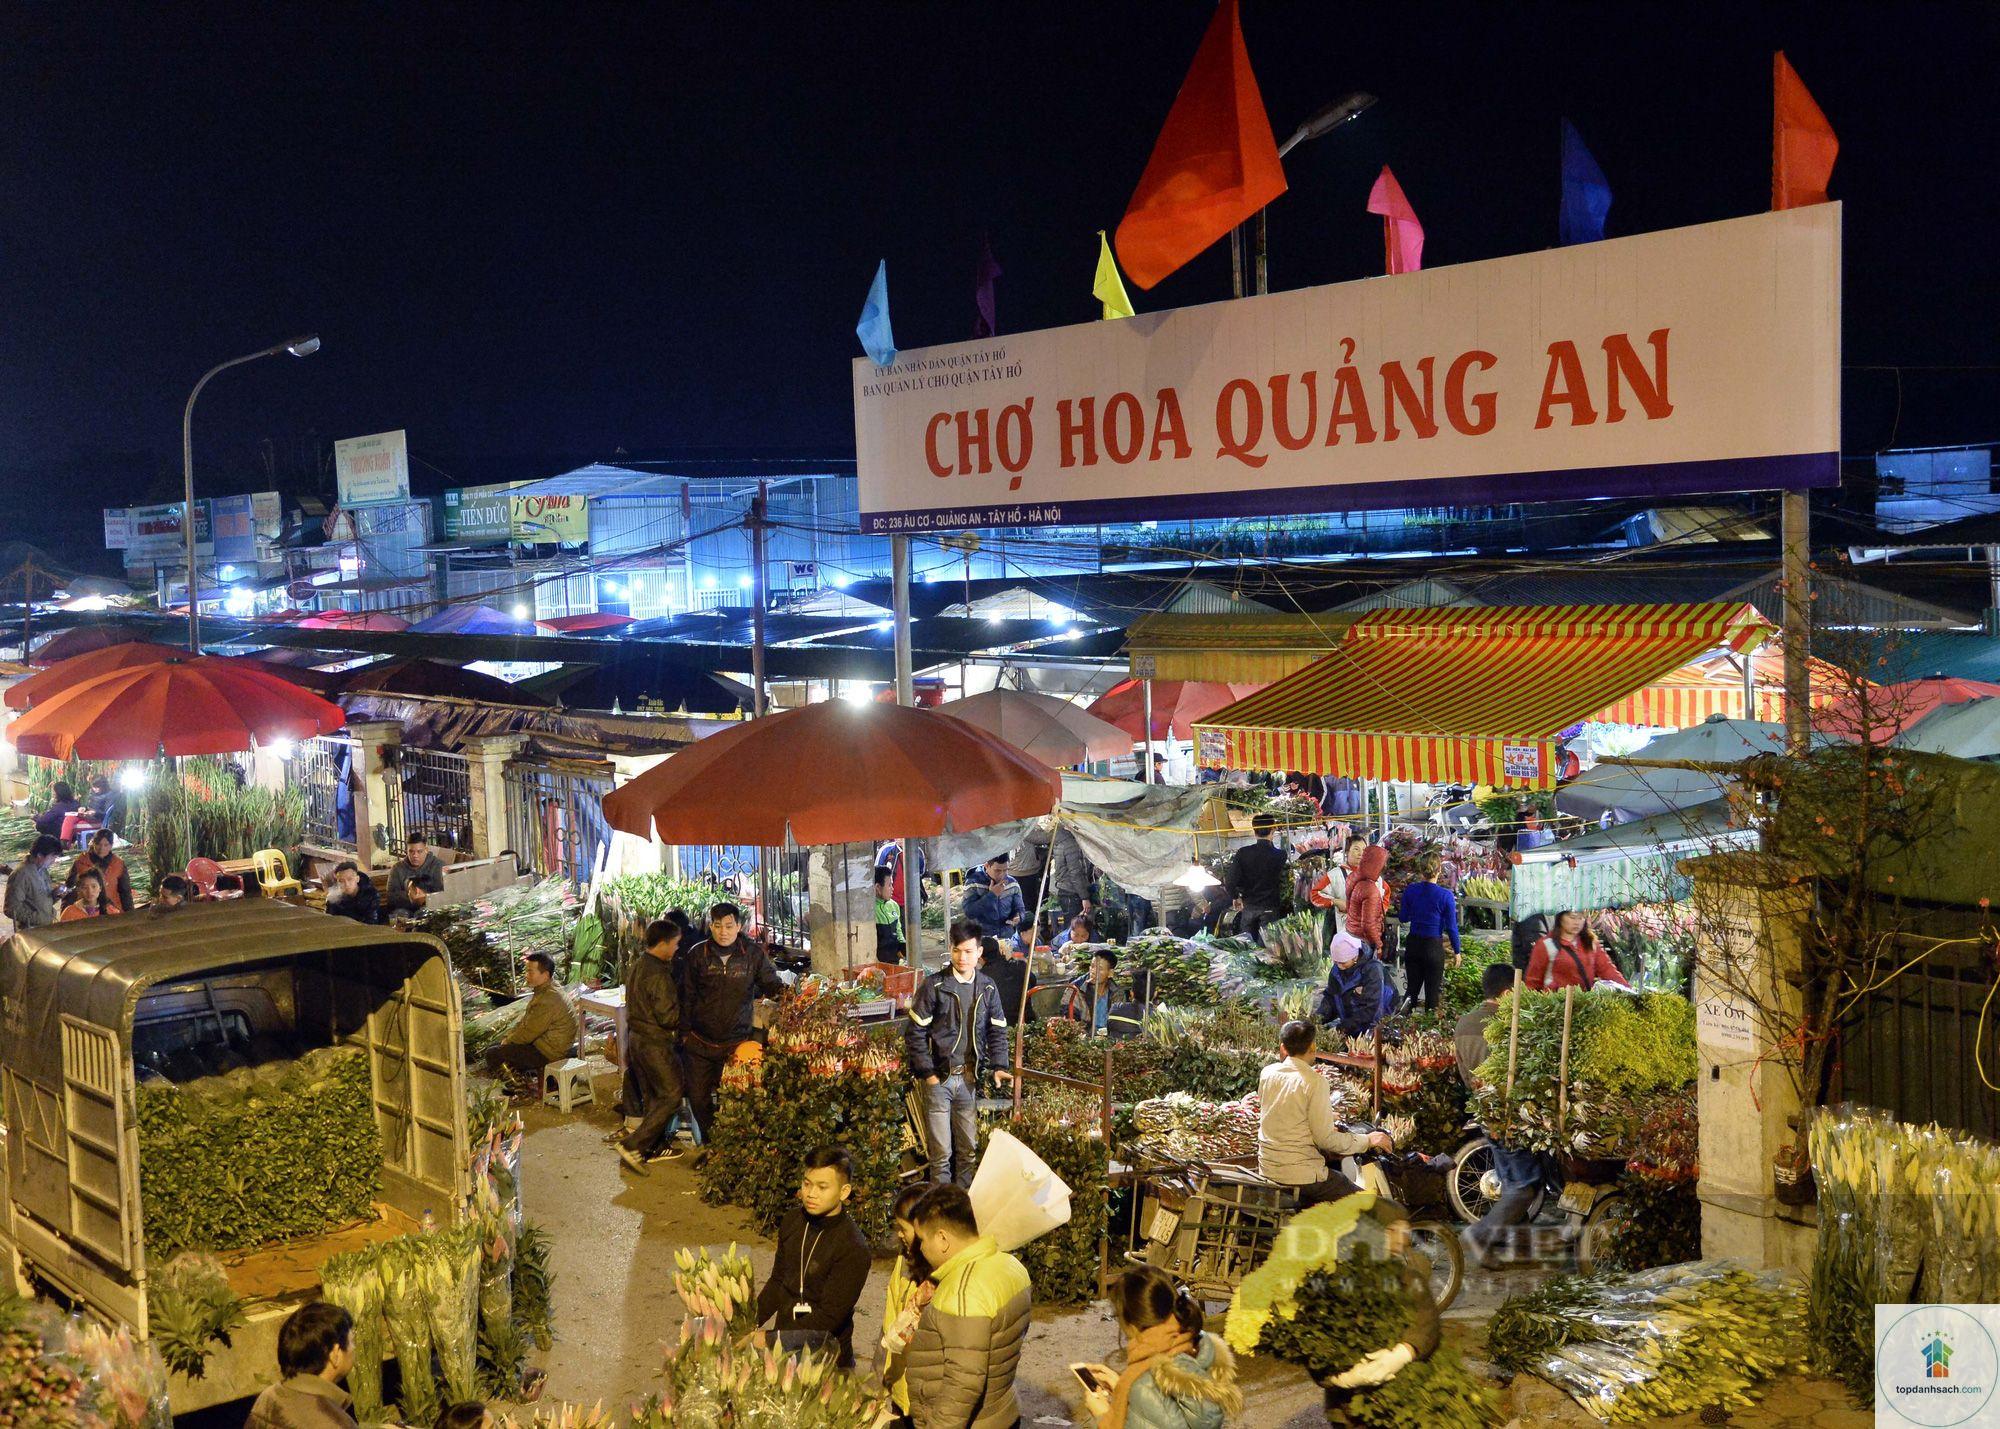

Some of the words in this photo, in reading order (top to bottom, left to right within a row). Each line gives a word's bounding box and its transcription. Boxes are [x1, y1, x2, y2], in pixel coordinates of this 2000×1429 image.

[863, 383, 882, 397] BAN
[912, 373, 926, 390] LÝ
[927, 372, 951, 390] CHỢ
[951, 368, 980, 388] QUẬN
[982, 364, 1003, 381] TÂY
[1006, 359, 1023, 379] HỒ
[924, 396, 1034, 491] CHỢ
[1056, 386, 1193, 468] HOA
[1215, 336, 1499, 469] QUẢNG
[1534, 328, 1674, 430] AN
[460, 500, 484, 526] TIẾN
[486, 501, 508, 525] ĐỨC
[872, 518, 888, 530] ĐC:
[888, 517, 903, 530] 236
[903, 514, 916, 528] ÂU
[917, 514, 930, 527] CƠ
[936, 510, 968, 527] QUẢNG
[968, 512, 982, 525] AN
[987, 509, 1006, 524] TÂY
[1028, 506, 1042, 522] HÀ
[1043, 505, 1062, 524] NỘI
[793, 563, 814, 575] WC
[1704, 1003, 1721, 1017] XE
